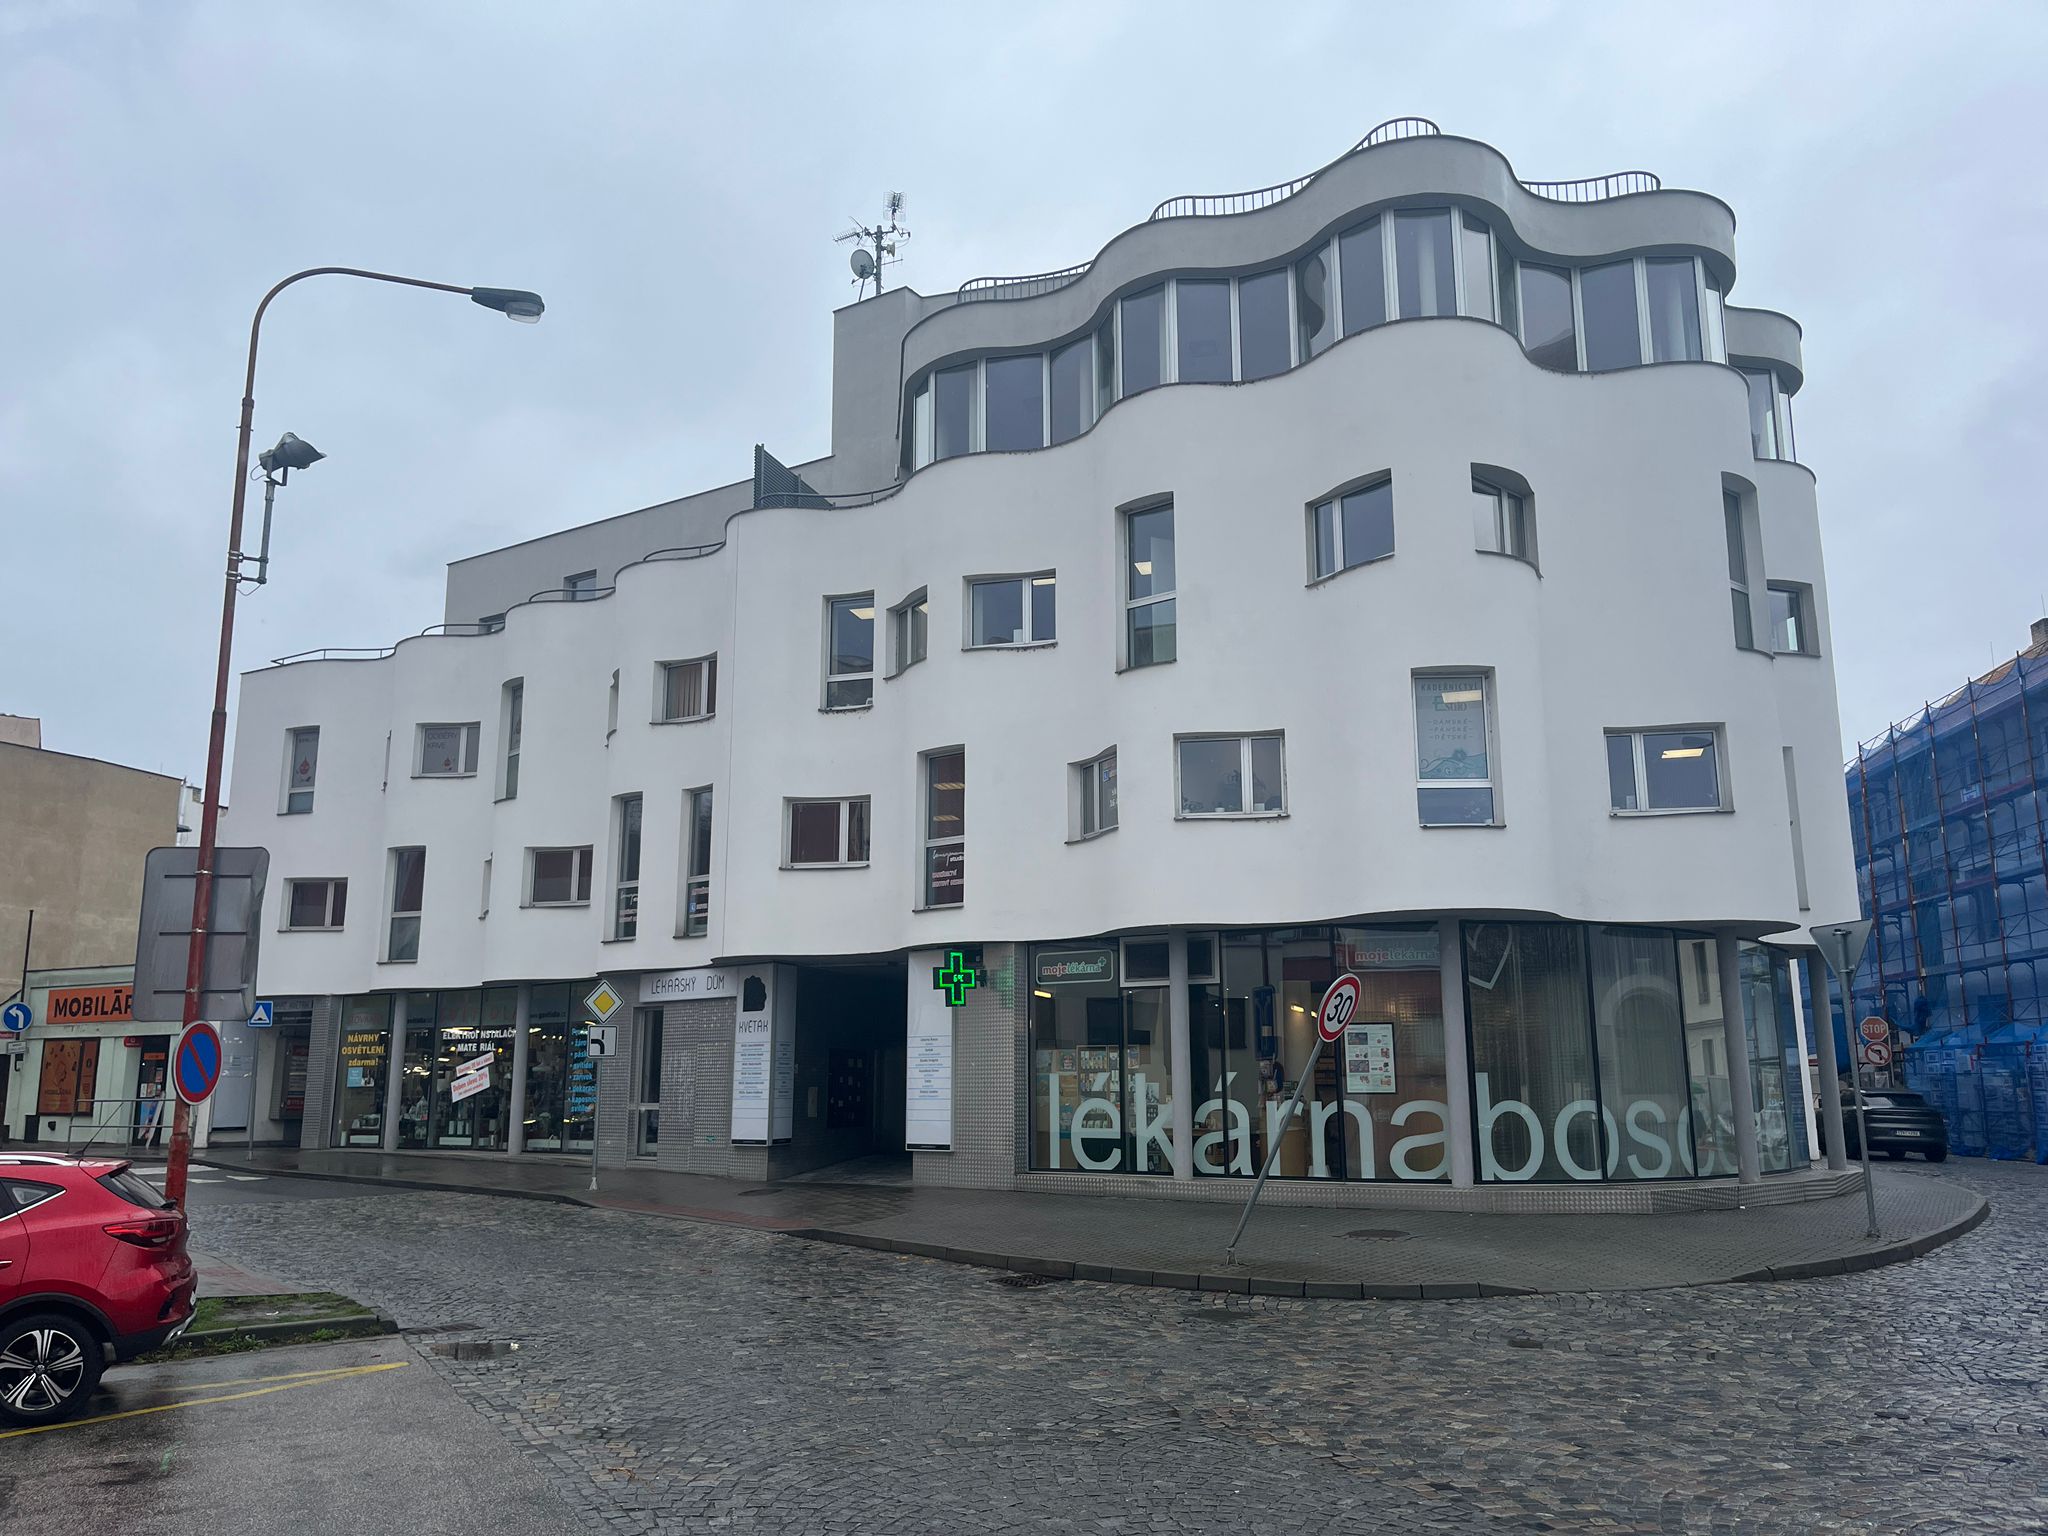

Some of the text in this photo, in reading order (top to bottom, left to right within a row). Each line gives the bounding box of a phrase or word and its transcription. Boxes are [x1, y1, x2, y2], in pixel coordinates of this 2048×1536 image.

[1326, 992, 1353, 1025] 30
[1862, 1024, 1886, 1034] STOP
[347, 1032, 380, 1043] NÁVRHY
